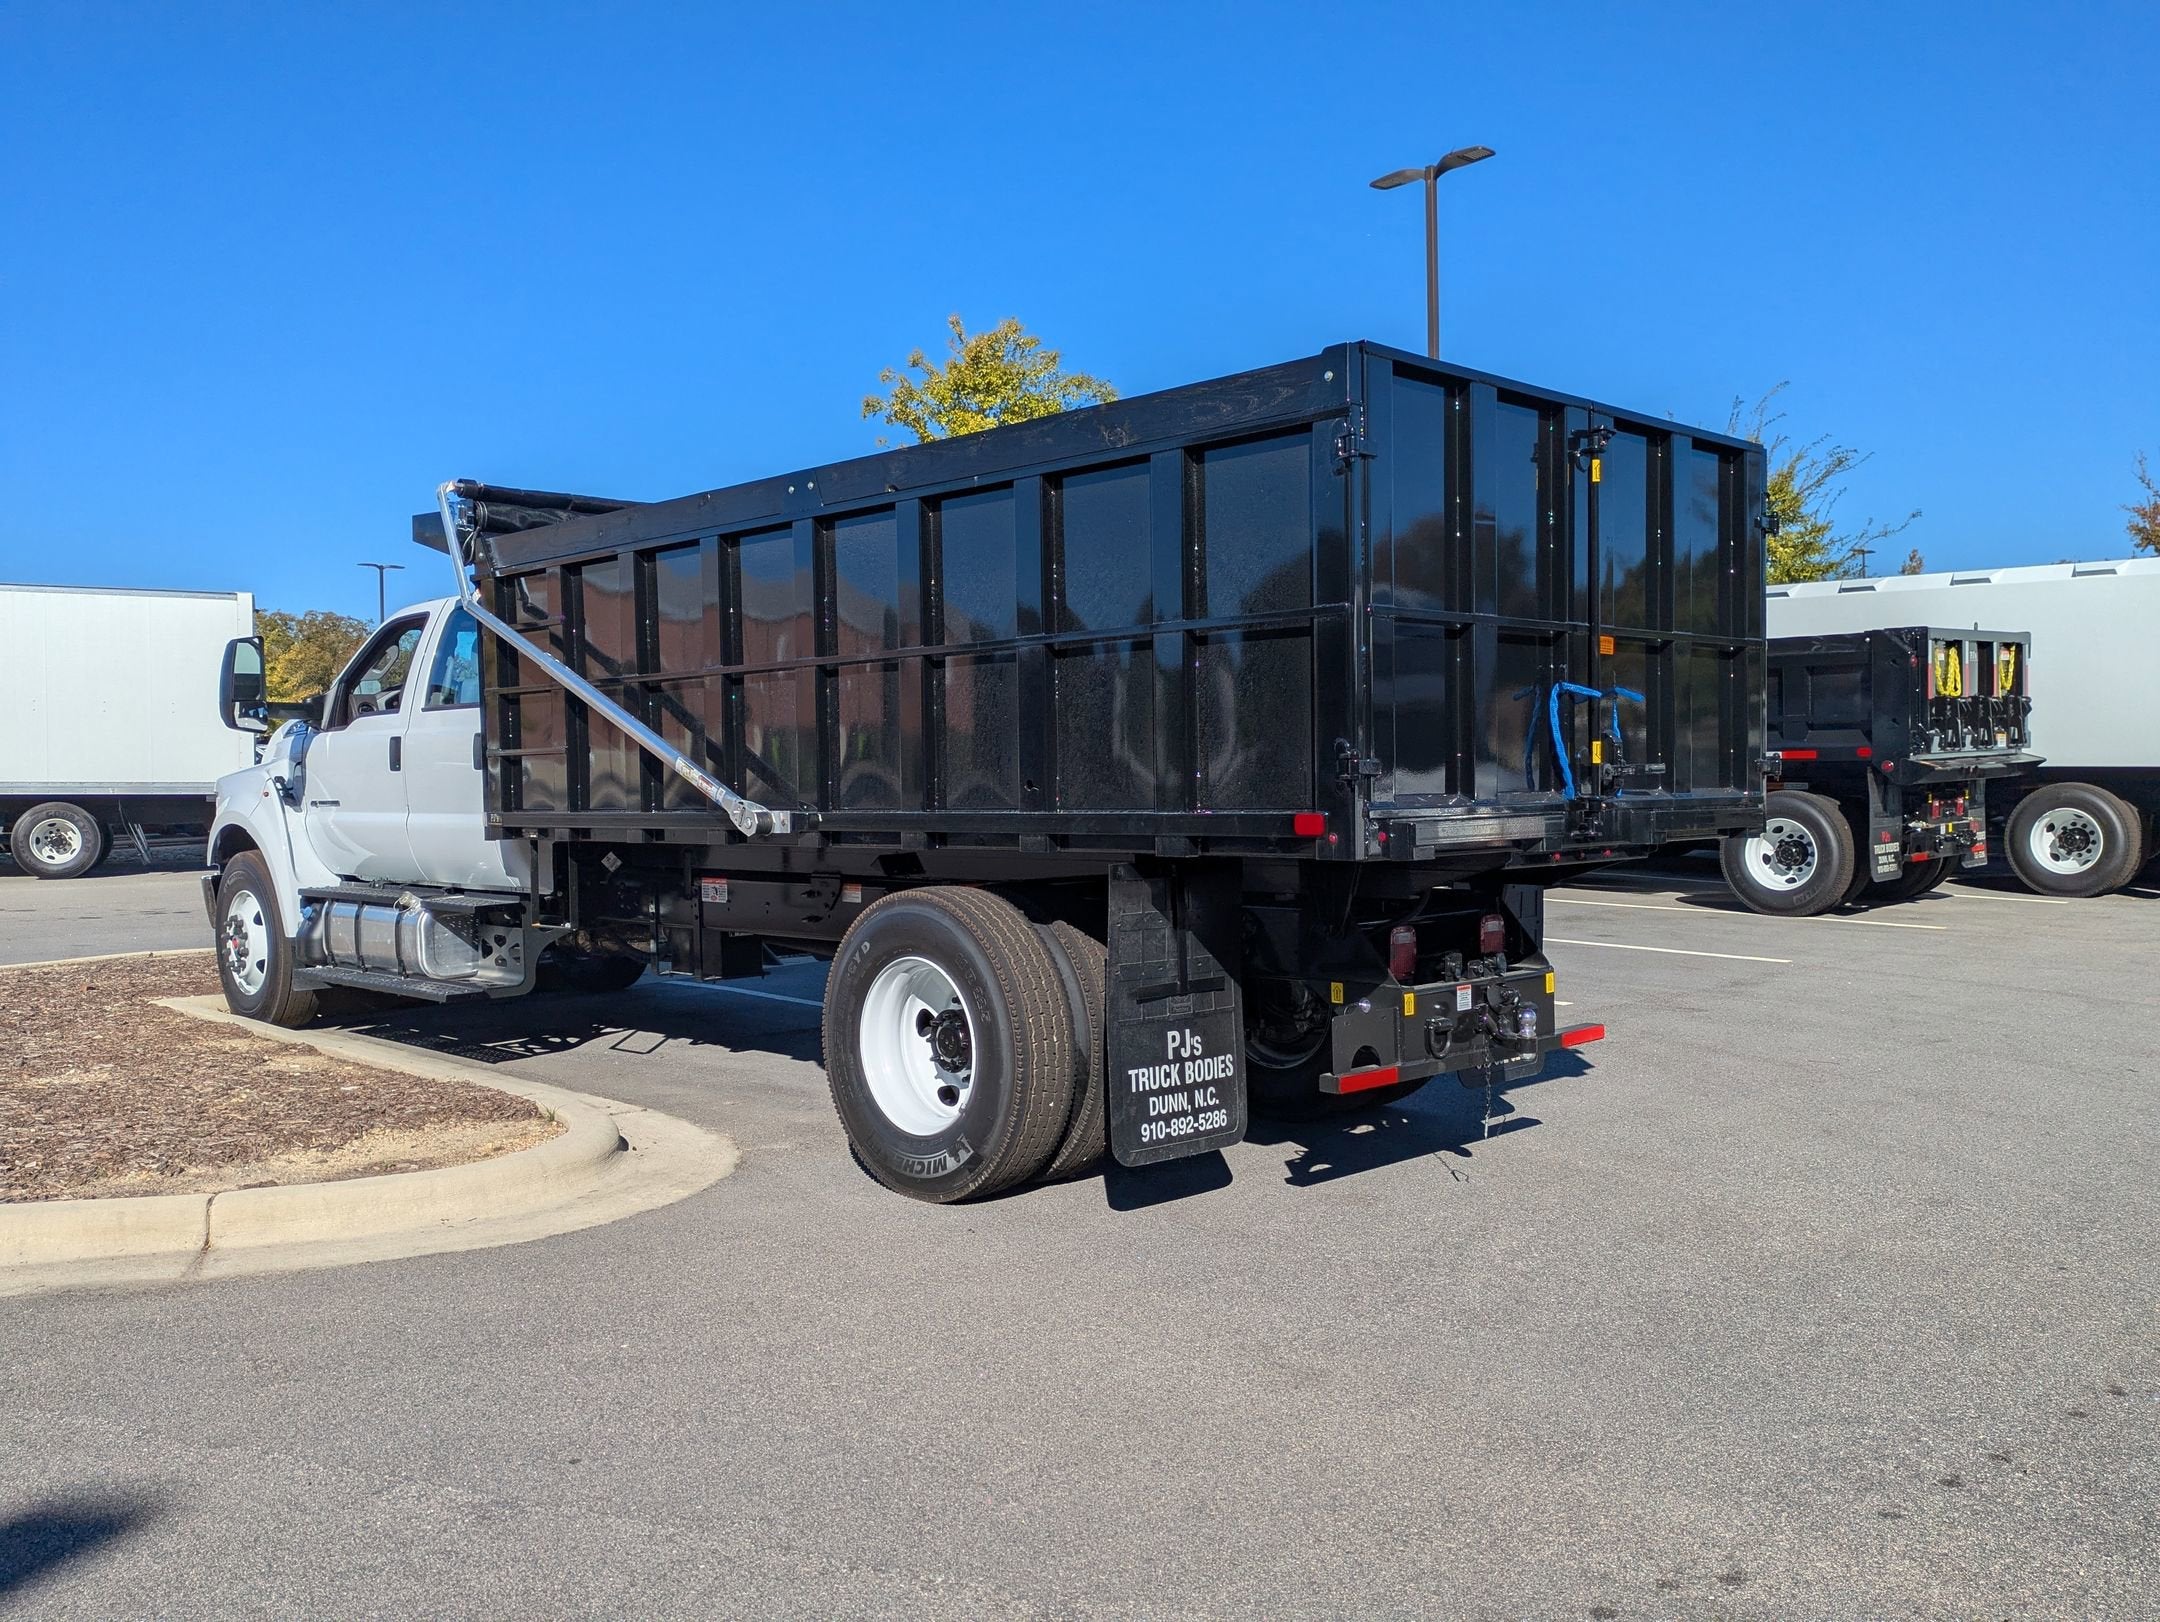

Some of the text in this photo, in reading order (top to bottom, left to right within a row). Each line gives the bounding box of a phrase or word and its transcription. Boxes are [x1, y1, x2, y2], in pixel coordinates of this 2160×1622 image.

[1128, 1053, 1234, 1093] TRUCK BODIES
[1149, 1086, 1220, 1117] DUNN, N.C.
[1141, 1109, 1228, 1143] 910-892-5286
